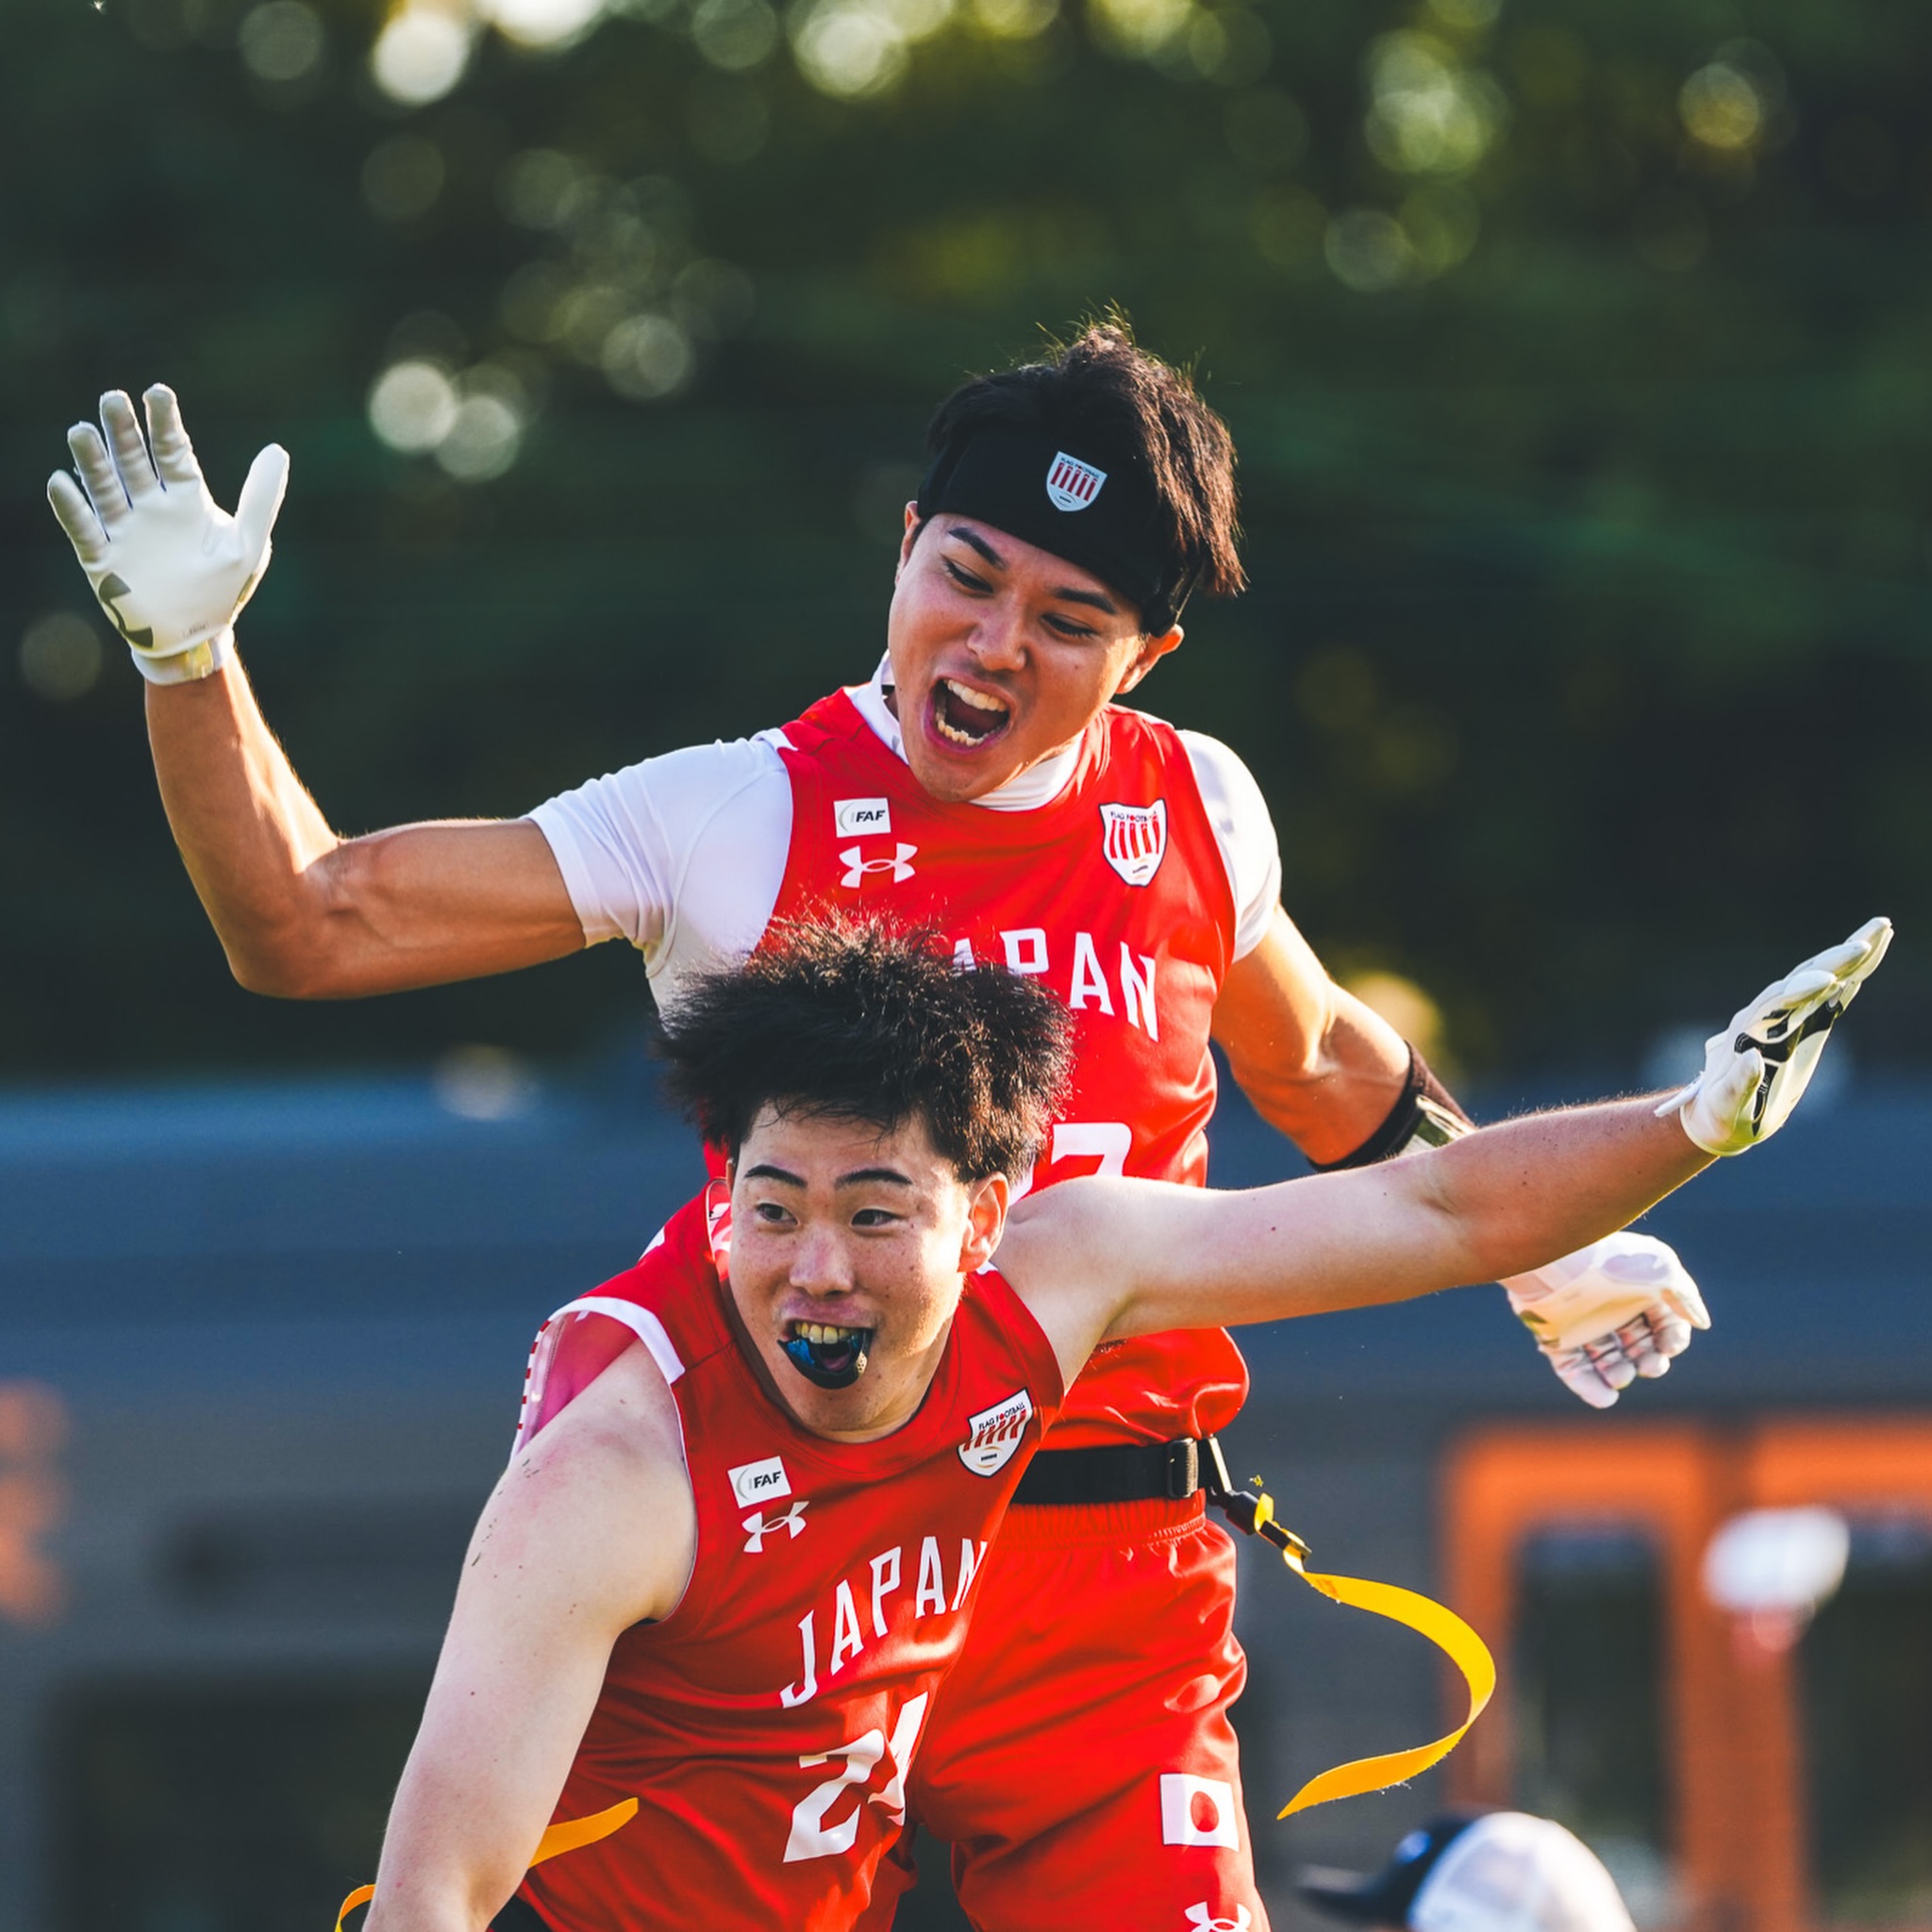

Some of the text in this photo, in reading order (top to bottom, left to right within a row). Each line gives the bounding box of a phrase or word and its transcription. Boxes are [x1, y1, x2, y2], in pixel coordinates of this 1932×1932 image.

[978, 1417, 995, 1430] FLAG
[748, 1471, 781, 1491] IFAF
[779, 1536, 988, 1708] JAPAN
